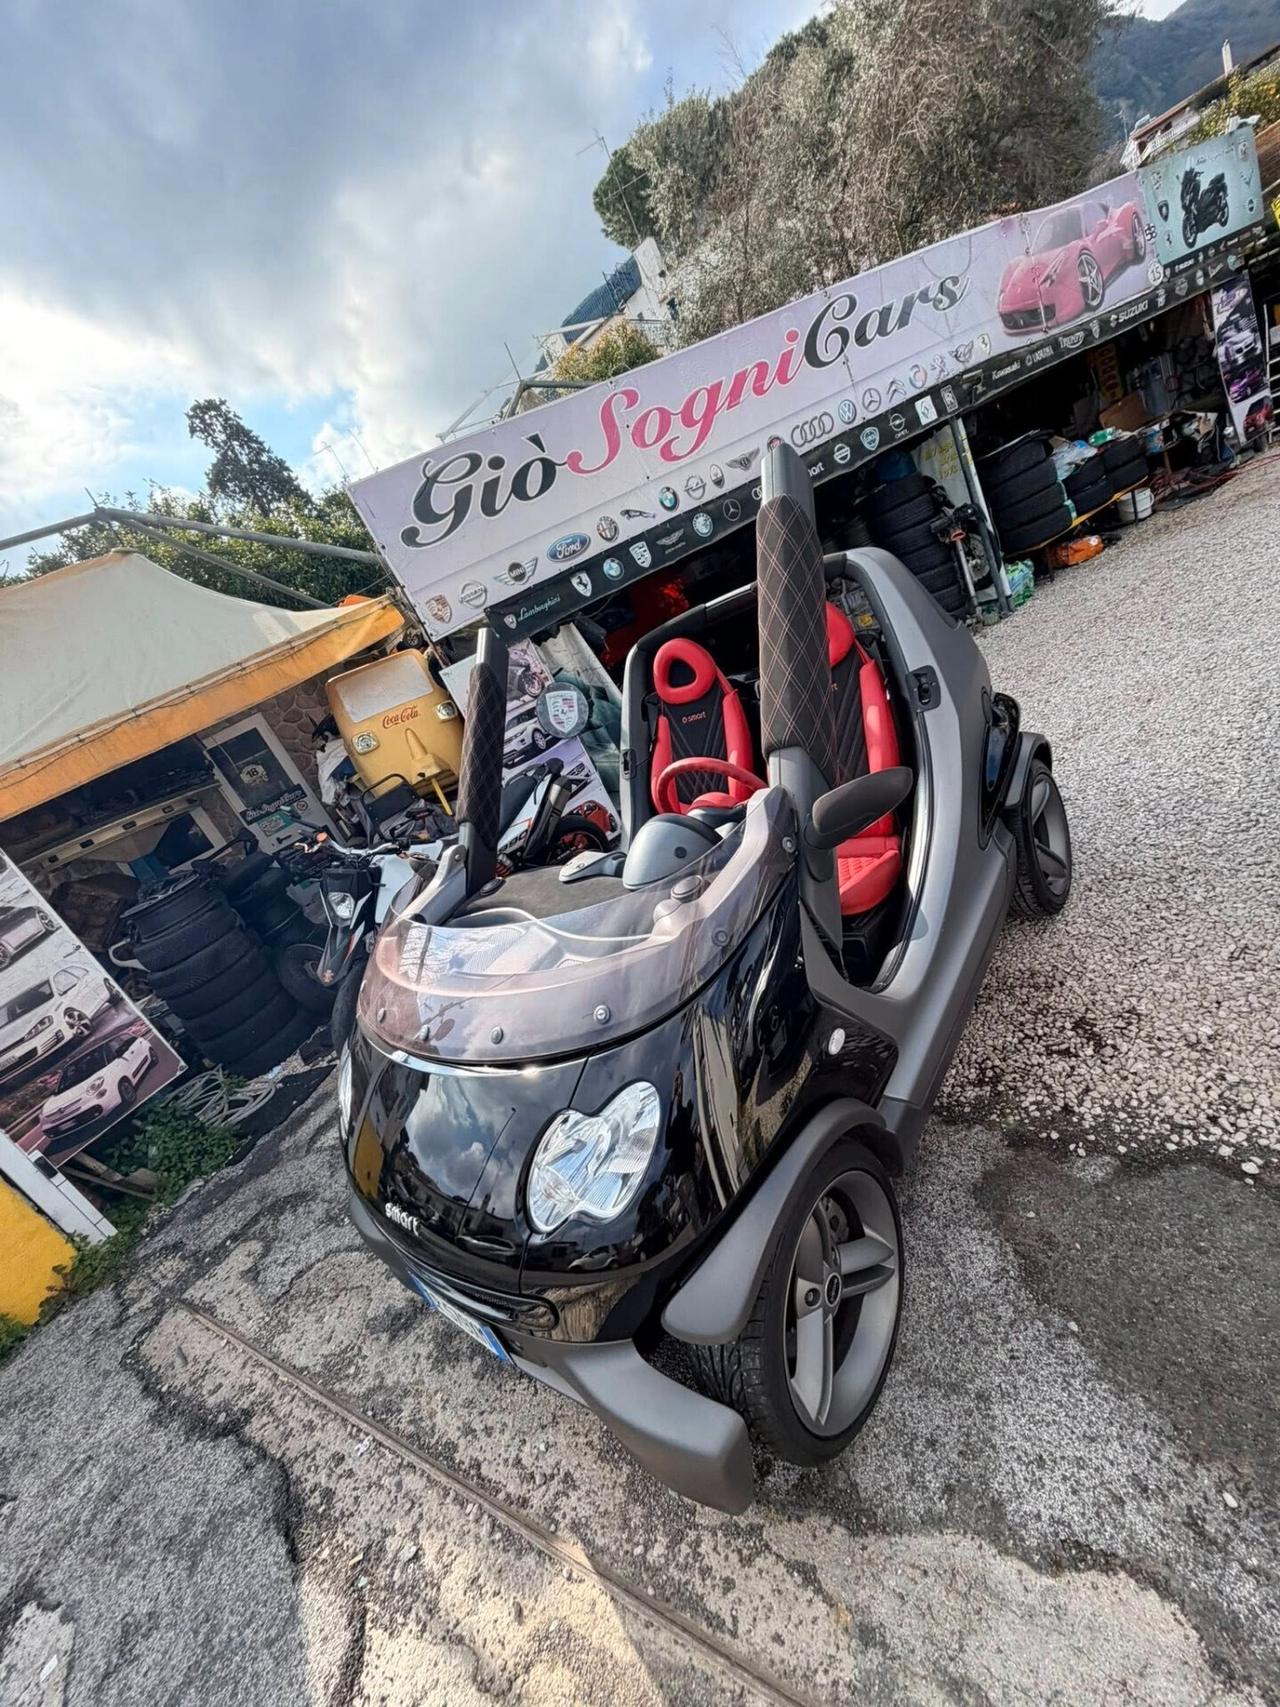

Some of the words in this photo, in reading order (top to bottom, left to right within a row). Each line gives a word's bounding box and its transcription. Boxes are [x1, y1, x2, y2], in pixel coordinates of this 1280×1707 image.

[1118, 300, 1148, 323] SUZUKI
[992, 360, 1021, 380] Kawasaki
[555, 540, 581, 559] Ford
[509, 566, 525, 577] MINI
[518, 594, 561, 622] Lamborghini
[687, 711, 707, 723] smart
[245, 767, 259, 778] 18
[385, 1202, 420, 1237] smart
